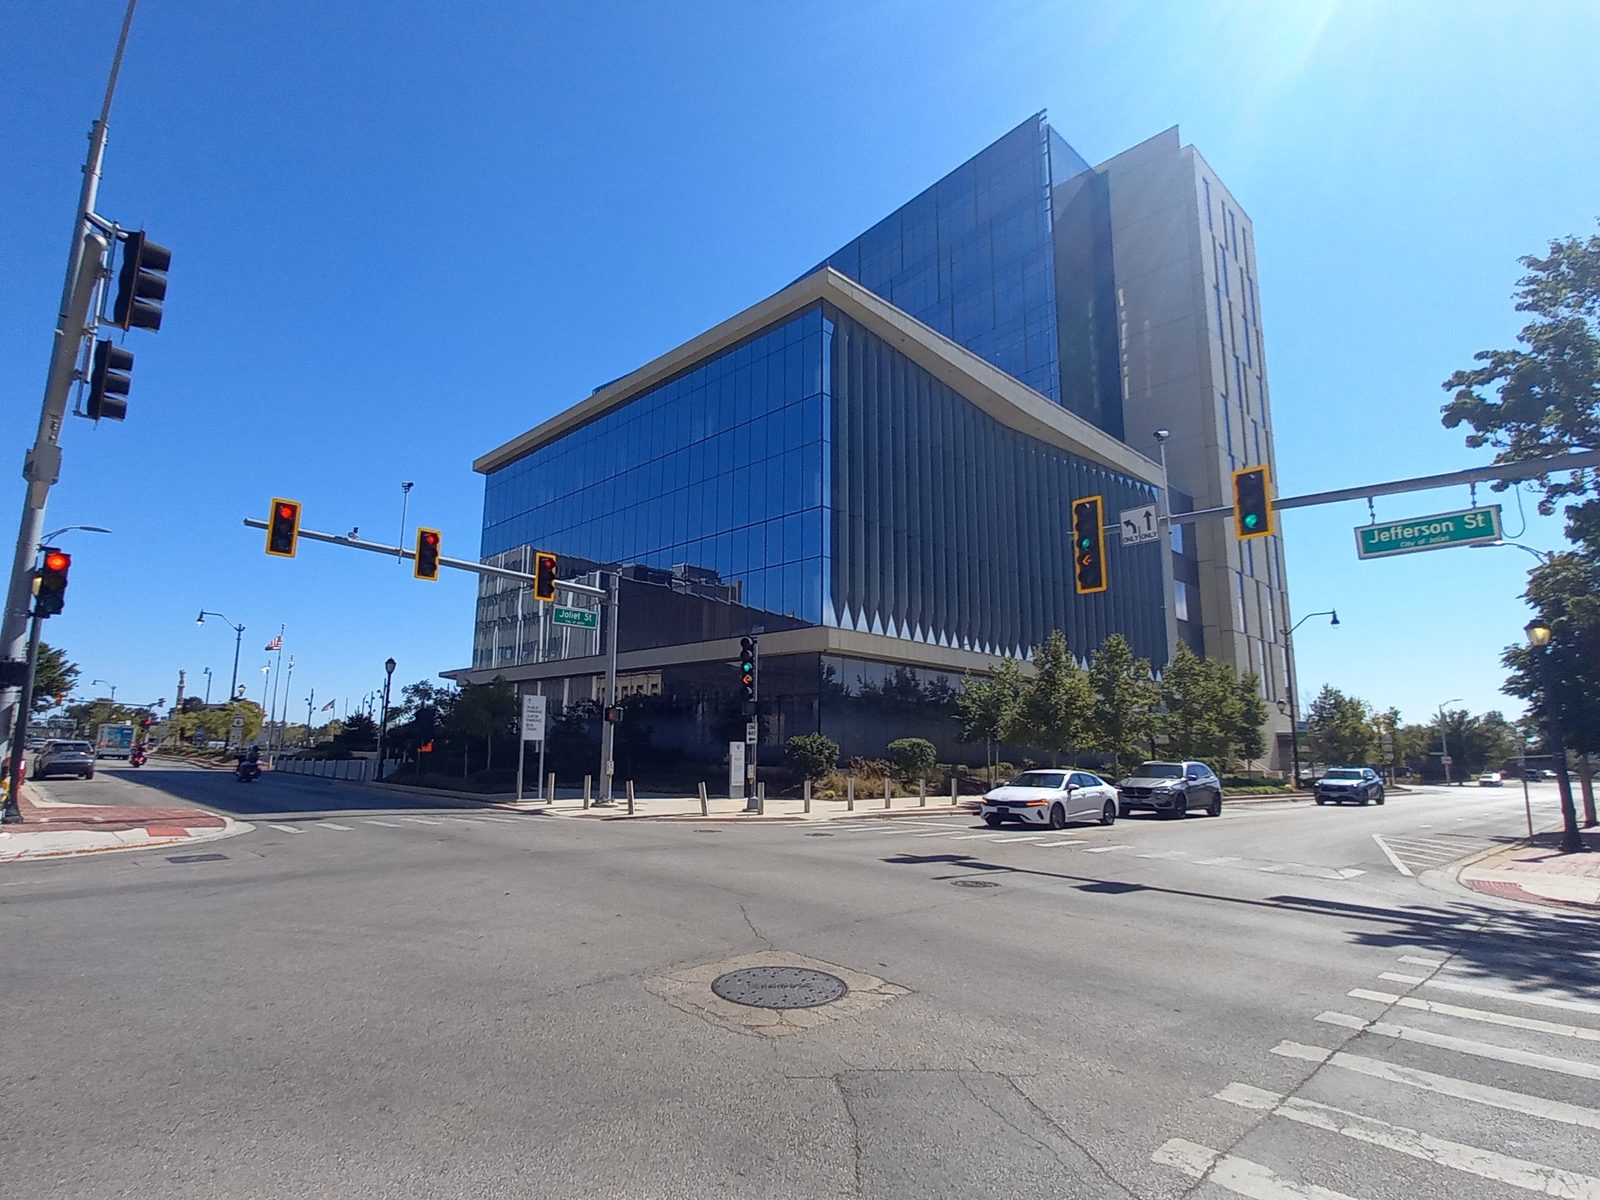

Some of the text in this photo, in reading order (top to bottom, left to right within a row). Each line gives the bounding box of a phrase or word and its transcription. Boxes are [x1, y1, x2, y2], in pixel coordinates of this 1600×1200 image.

[1369, 513, 1485, 543] Jefferson St
[559, 610, 581, 620] Joliet
[584, 613, 592, 622] St
